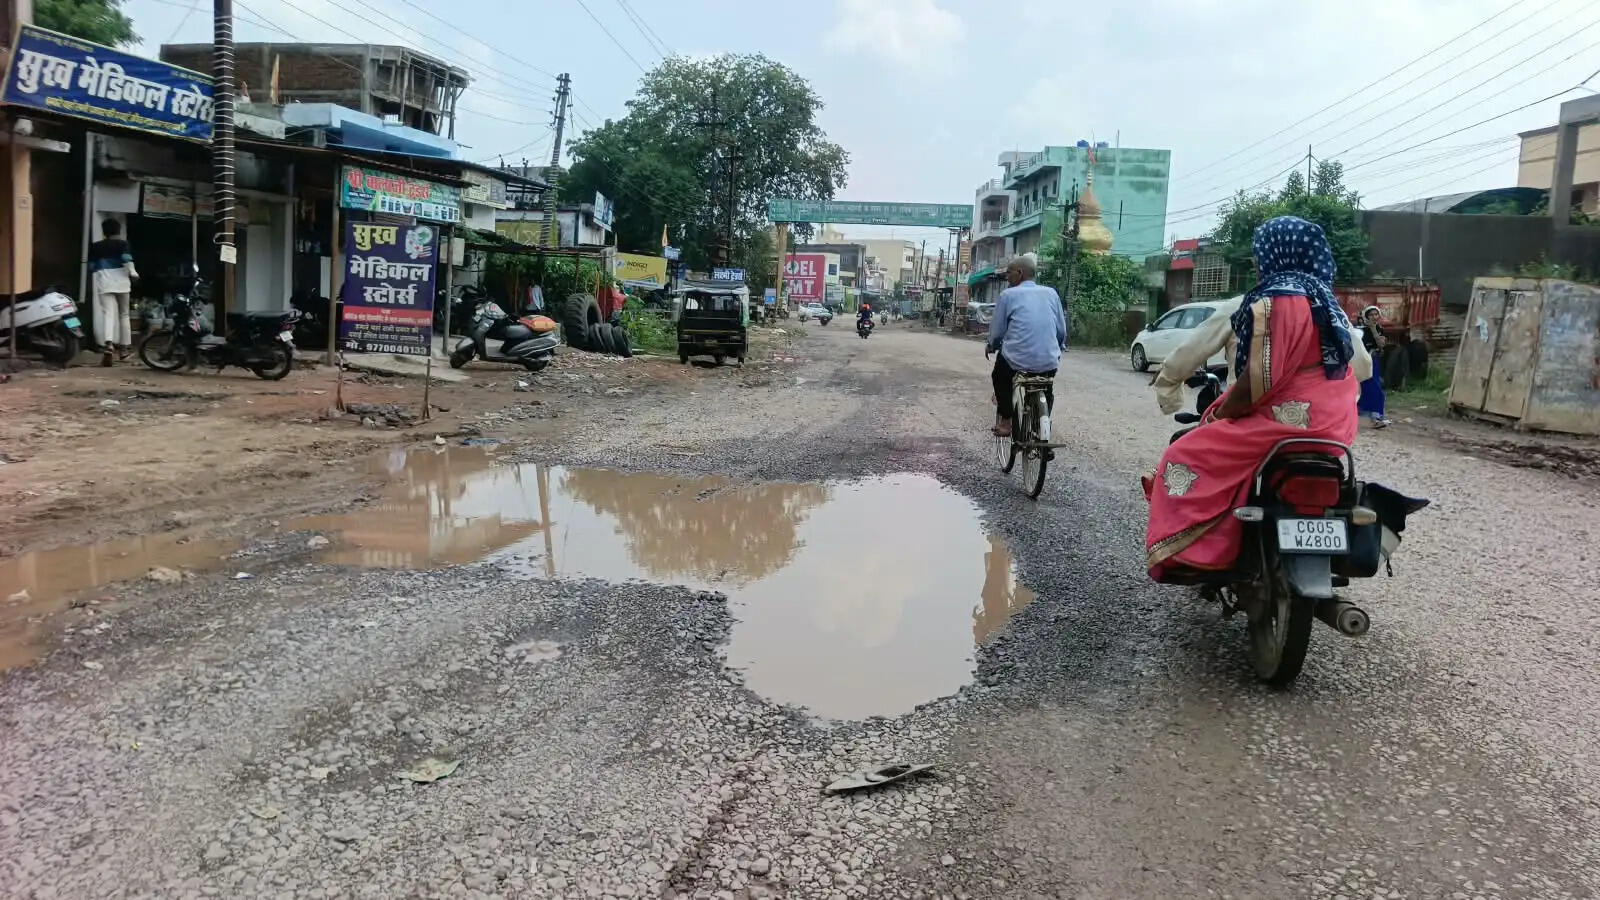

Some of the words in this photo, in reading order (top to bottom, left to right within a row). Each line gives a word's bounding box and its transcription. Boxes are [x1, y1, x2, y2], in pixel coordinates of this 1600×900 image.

[17, 49, 77, 93] सुख
[78, 56, 170, 111] मेडिकल
[352, 224, 399, 251] सुख
[350, 255, 432, 281] मेडिकल
[362, 282, 418, 305] स्टोर्स
[1297, 520, 1334, 534] CG05
[1295, 535, 1341, 548] W4800
